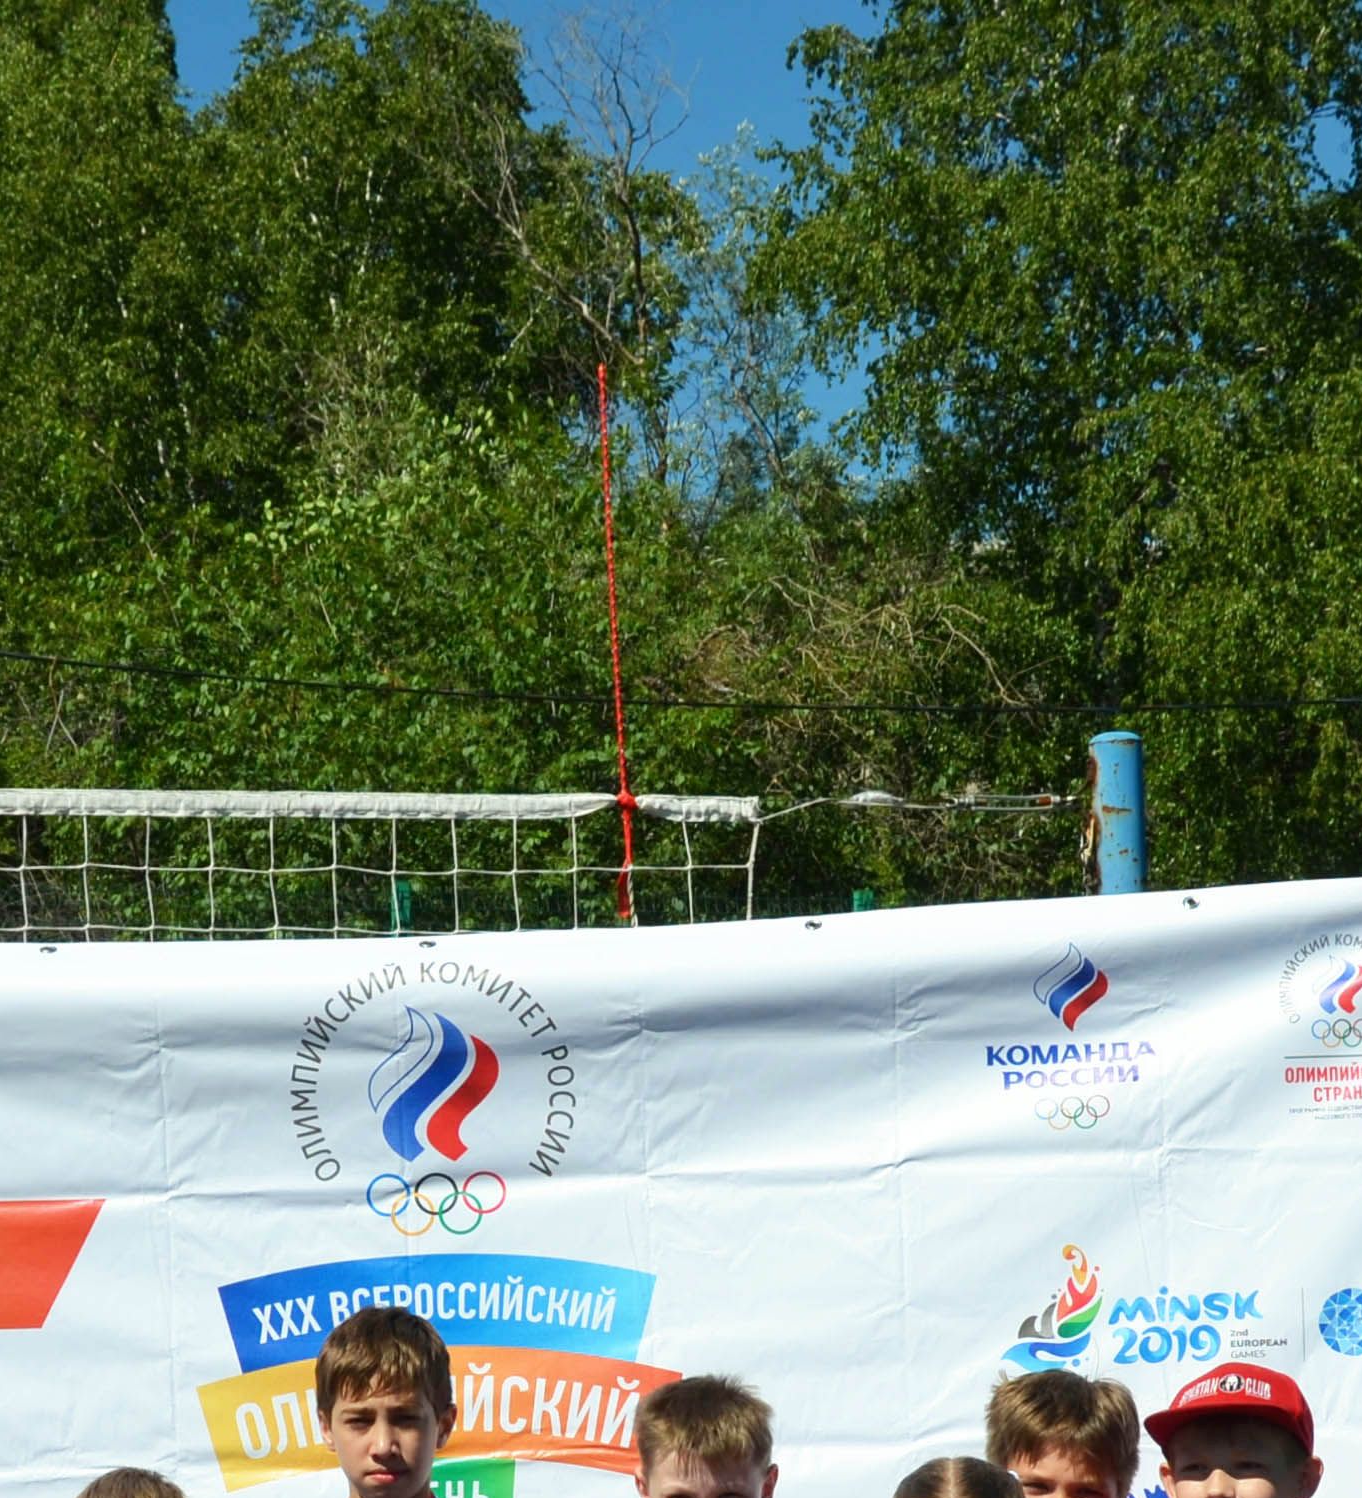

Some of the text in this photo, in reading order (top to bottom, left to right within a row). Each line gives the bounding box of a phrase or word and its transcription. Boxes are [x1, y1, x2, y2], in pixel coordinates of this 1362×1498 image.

[985, 1041, 1157, 1067] КОМАНДА
[289, 961, 577, 1182] ОЛИМПИЙСКИЙ КОМИТЕТ РОССИИ
[1002, 1065, 1140, 1091] РОССИИ
[1112, 1324, 1222, 1364] 2019
[1229, 1329, 1250, 1338] 2nd
[1229, 1338, 1289, 1349] EUROPEAN
[1229, 1349, 1267, 1360] GAMES
[1245, 1378, 1272, 1400] CLUB
